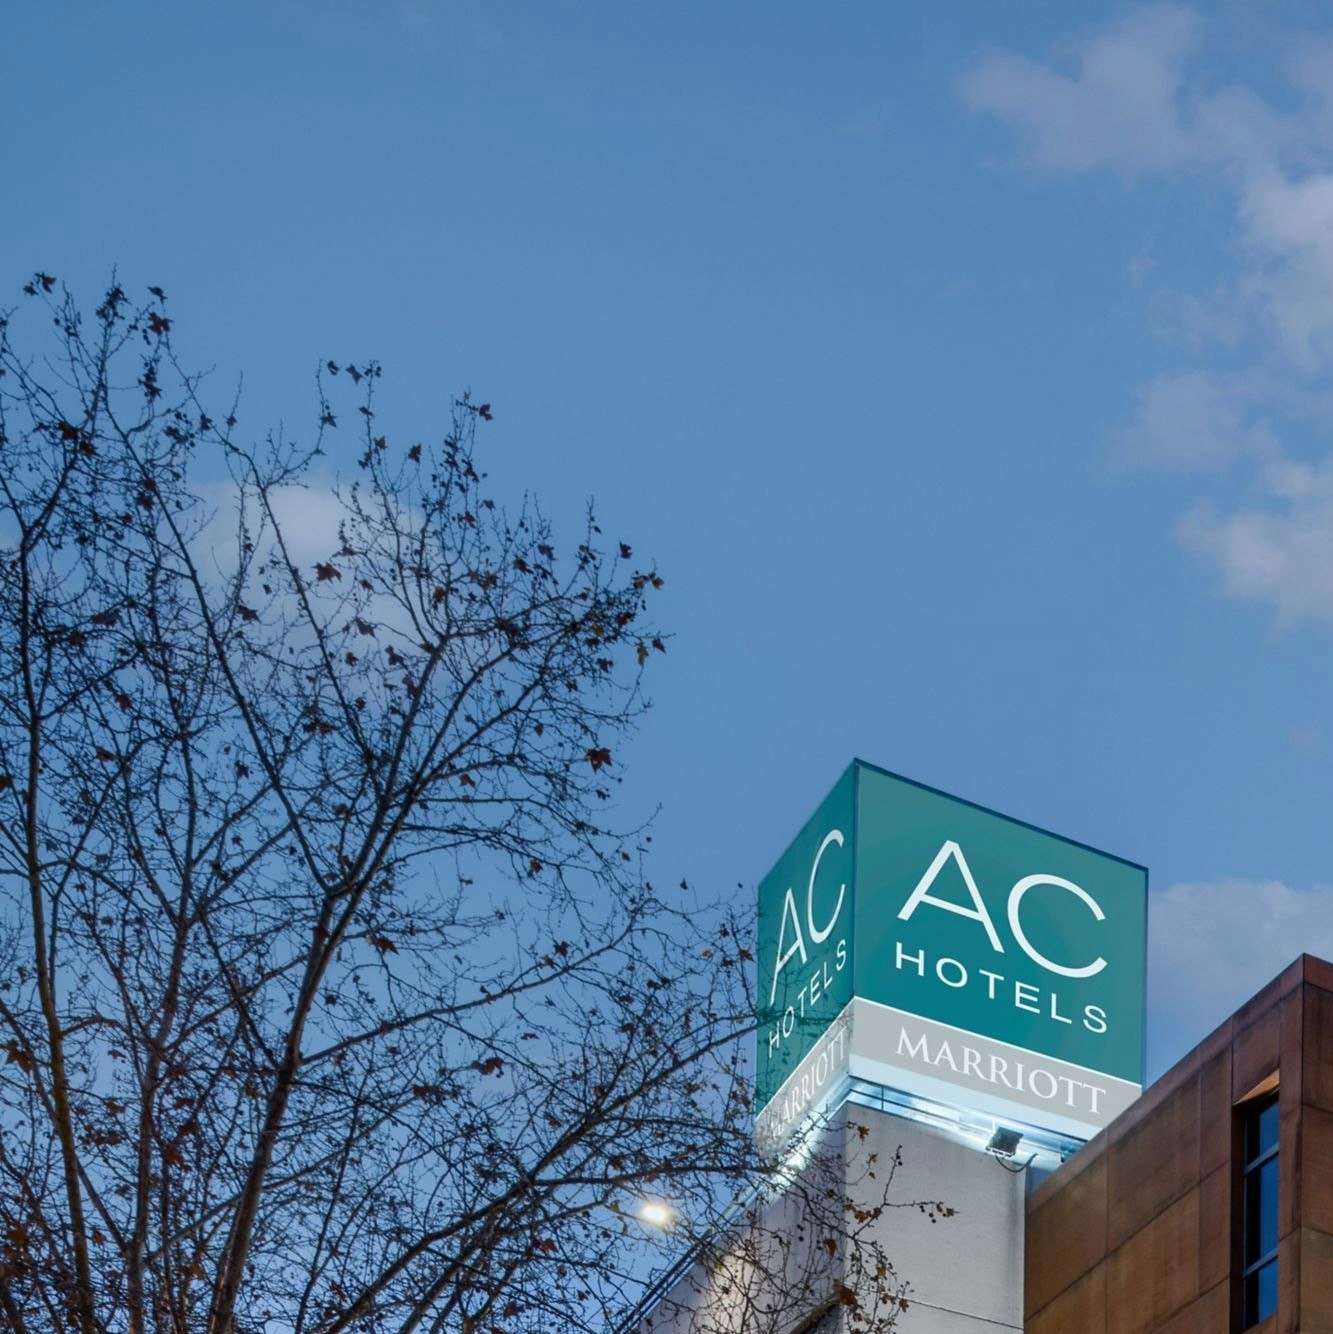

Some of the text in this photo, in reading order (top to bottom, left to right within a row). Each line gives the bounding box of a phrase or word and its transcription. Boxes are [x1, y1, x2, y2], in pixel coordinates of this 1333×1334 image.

[770, 829, 846, 1005] AC
[897, 839, 1108, 979] AC
[768, 938, 847, 1058] HOTELS
[895, 942, 1108, 1034] HOTELS
[894, 1027, 1107, 1114] MARRIOTT
